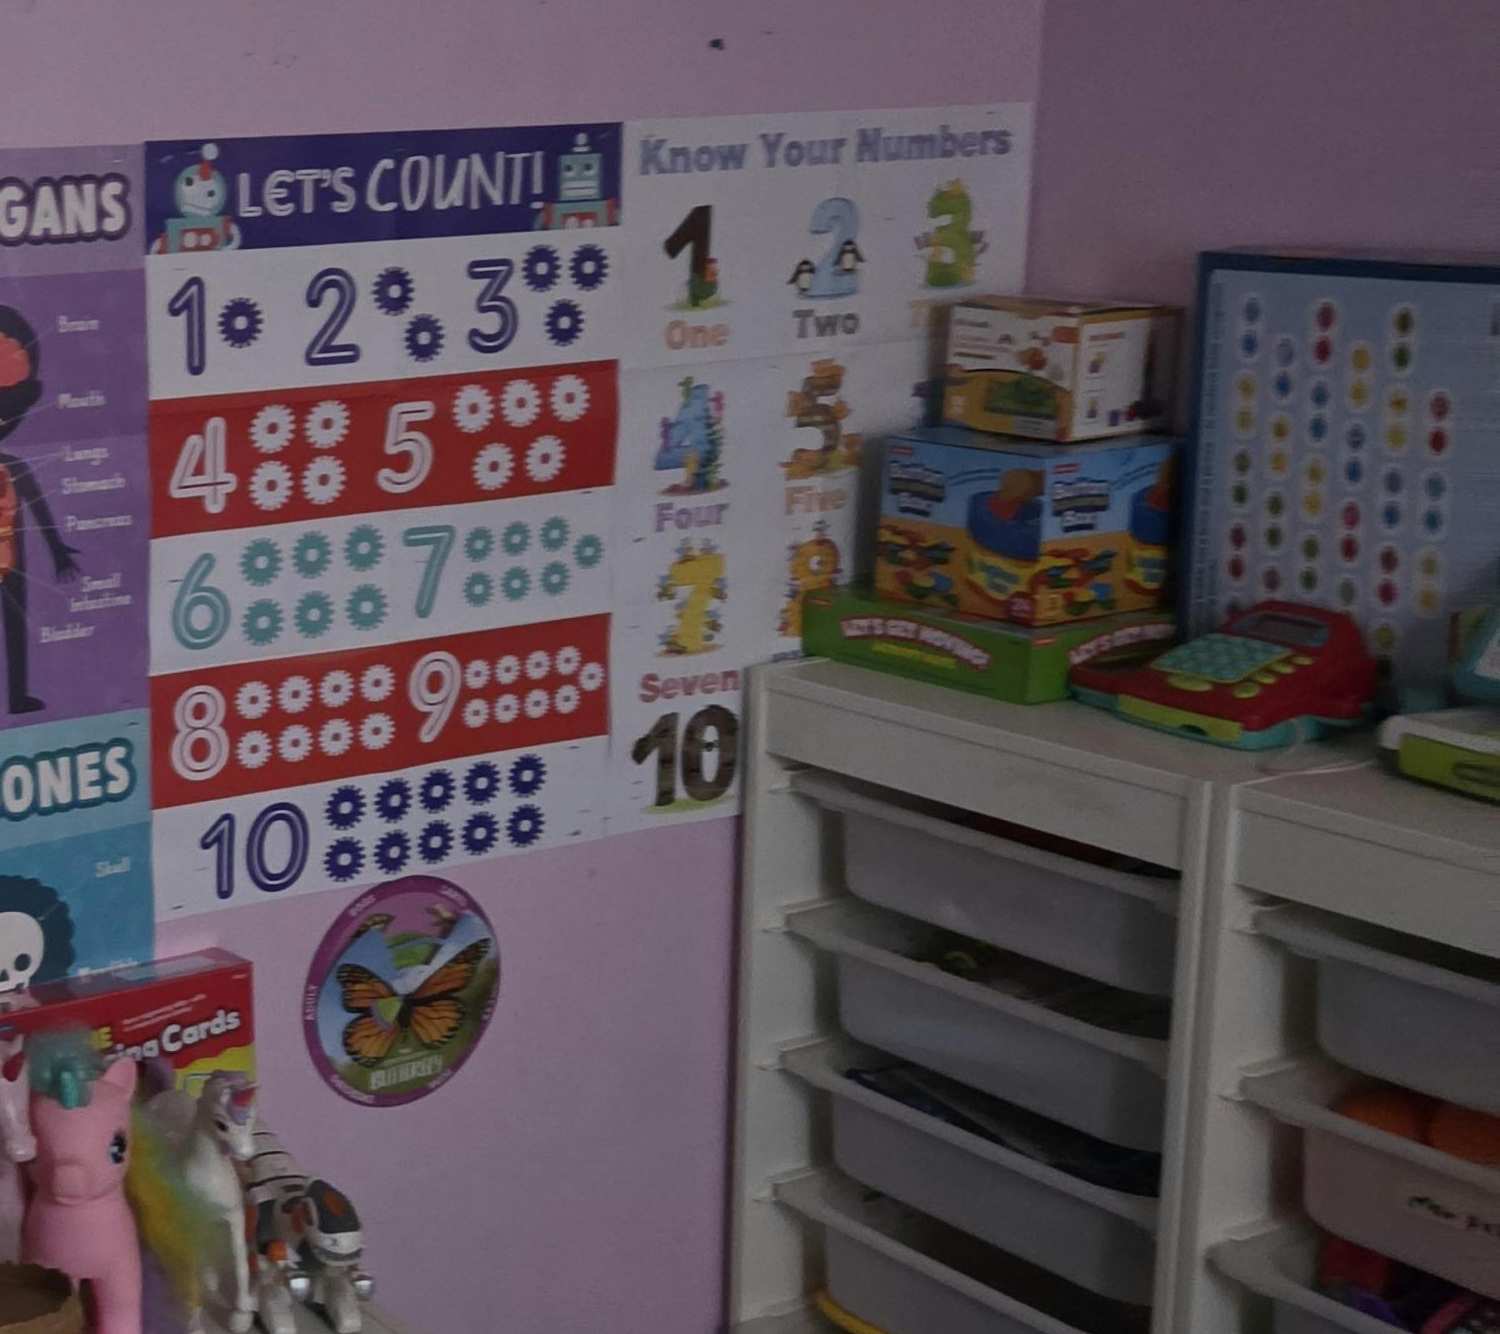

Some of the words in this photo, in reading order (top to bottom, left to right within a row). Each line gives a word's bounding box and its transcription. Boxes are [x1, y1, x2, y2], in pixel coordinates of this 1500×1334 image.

[236, 166, 357, 218] LET'S
[366, 150, 545, 212] COUNT!
[638, 136, 749, 175] Know
[759, 131, 847, 168] Your
[856, 124, 1013, 163] Numbers
[664, 204, 718, 307] 1
[809, 197, 860, 300] 2
[168, 275, 206, 376] 1
[304, 267, 360, 366] 2
[466, 258, 519, 354] 3
[665, 319, 729, 350] One
[791, 308, 860, 339] Two
[168, 416, 238, 514] 4
[376, 400, 436, 494] 5
[655, 502, 730, 532] Four
[171, 552, 231, 650] 6
[402, 524, 456, 619] 7
[666, 553, 724, 654] 7
[170, 685, 230, 781] 8
[408, 651, 462, 743] 9
[639, 669, 741, 704] Seven
[631, 703, 740, 807] 10
[200, 802, 309, 899] 10
[161, 1008, 241, 1053] Cards
